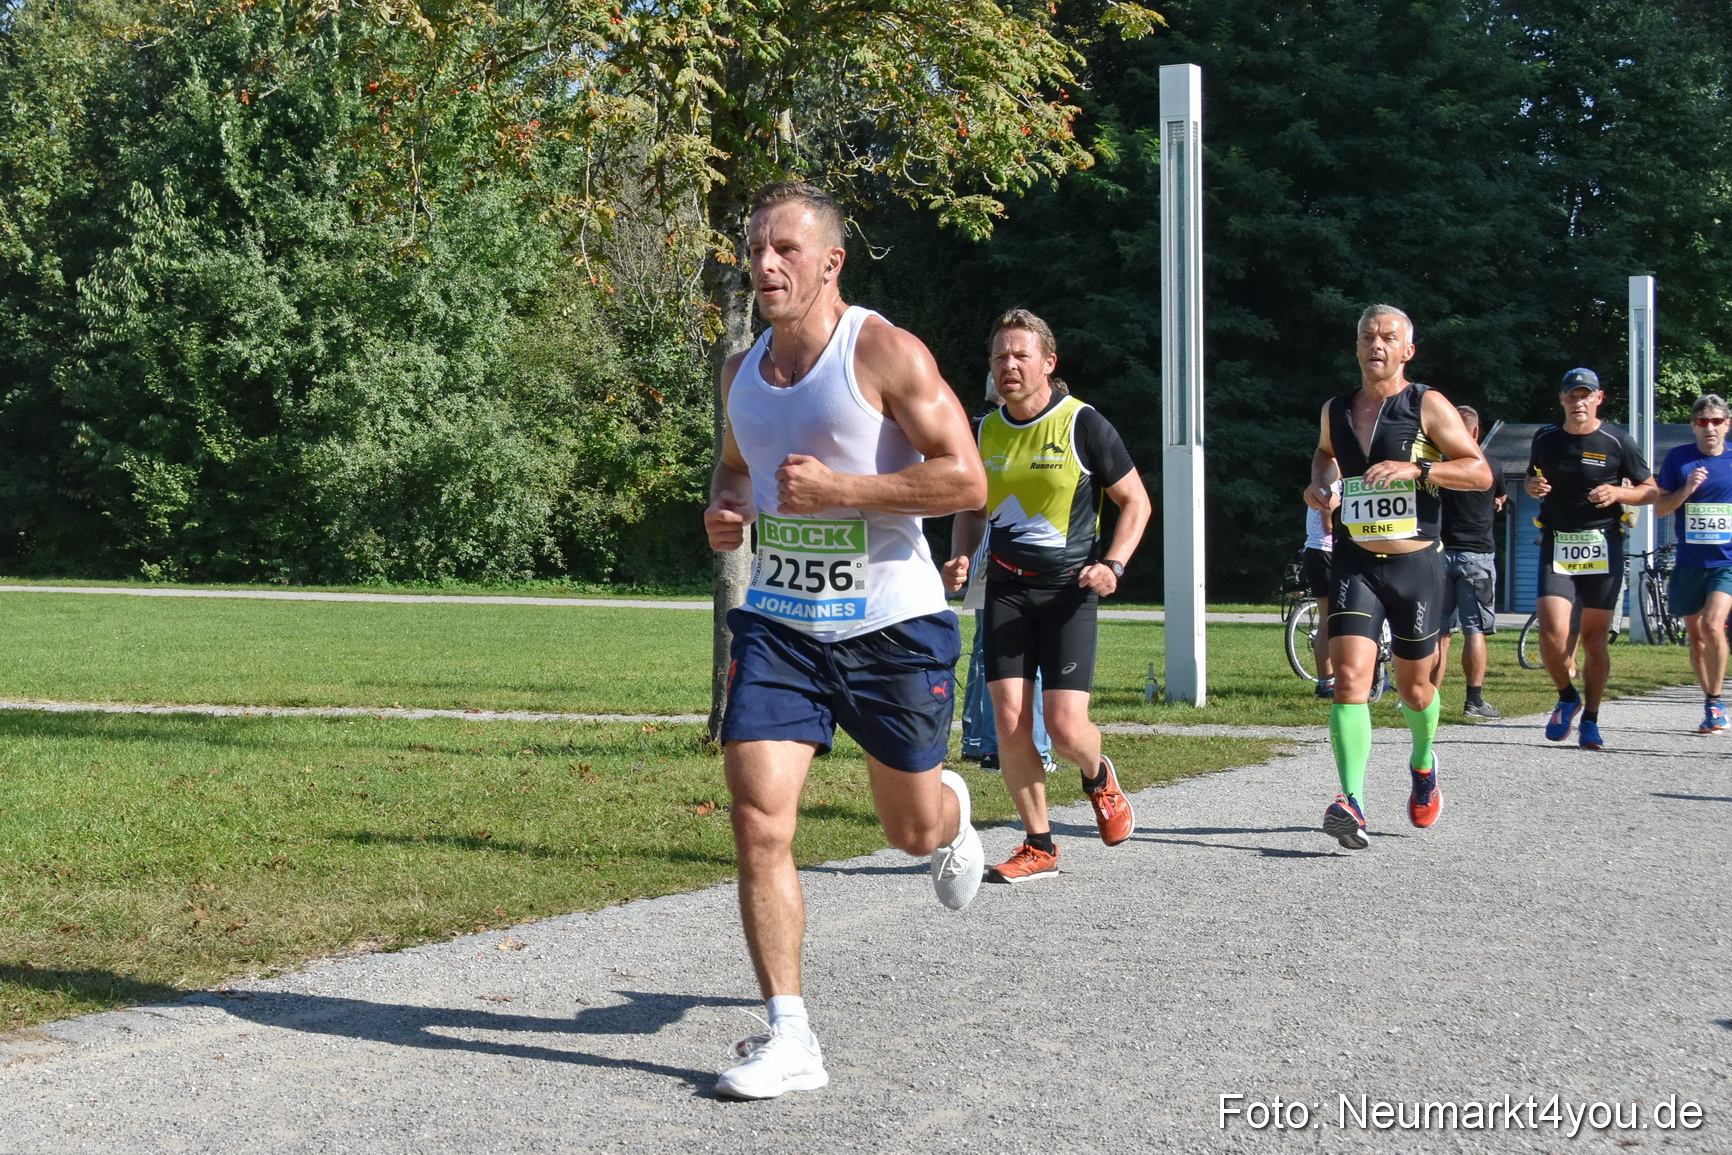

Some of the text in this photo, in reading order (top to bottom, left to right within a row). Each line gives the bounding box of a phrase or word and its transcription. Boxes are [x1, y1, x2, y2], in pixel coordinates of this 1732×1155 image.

[1351, 497, 1407, 519] 1180
[1687, 504, 1729, 515] BOCK
[1362, 524, 1393, 533] RENE
[1690, 518, 1726, 529] 2548
[766, 520, 853, 548] BOCK
[1558, 533, 1601, 541] BOCK
[1561, 545, 1601, 559] 1009
[766, 554, 853, 593] 2256
[756, 597, 856, 618] JOHANNES
